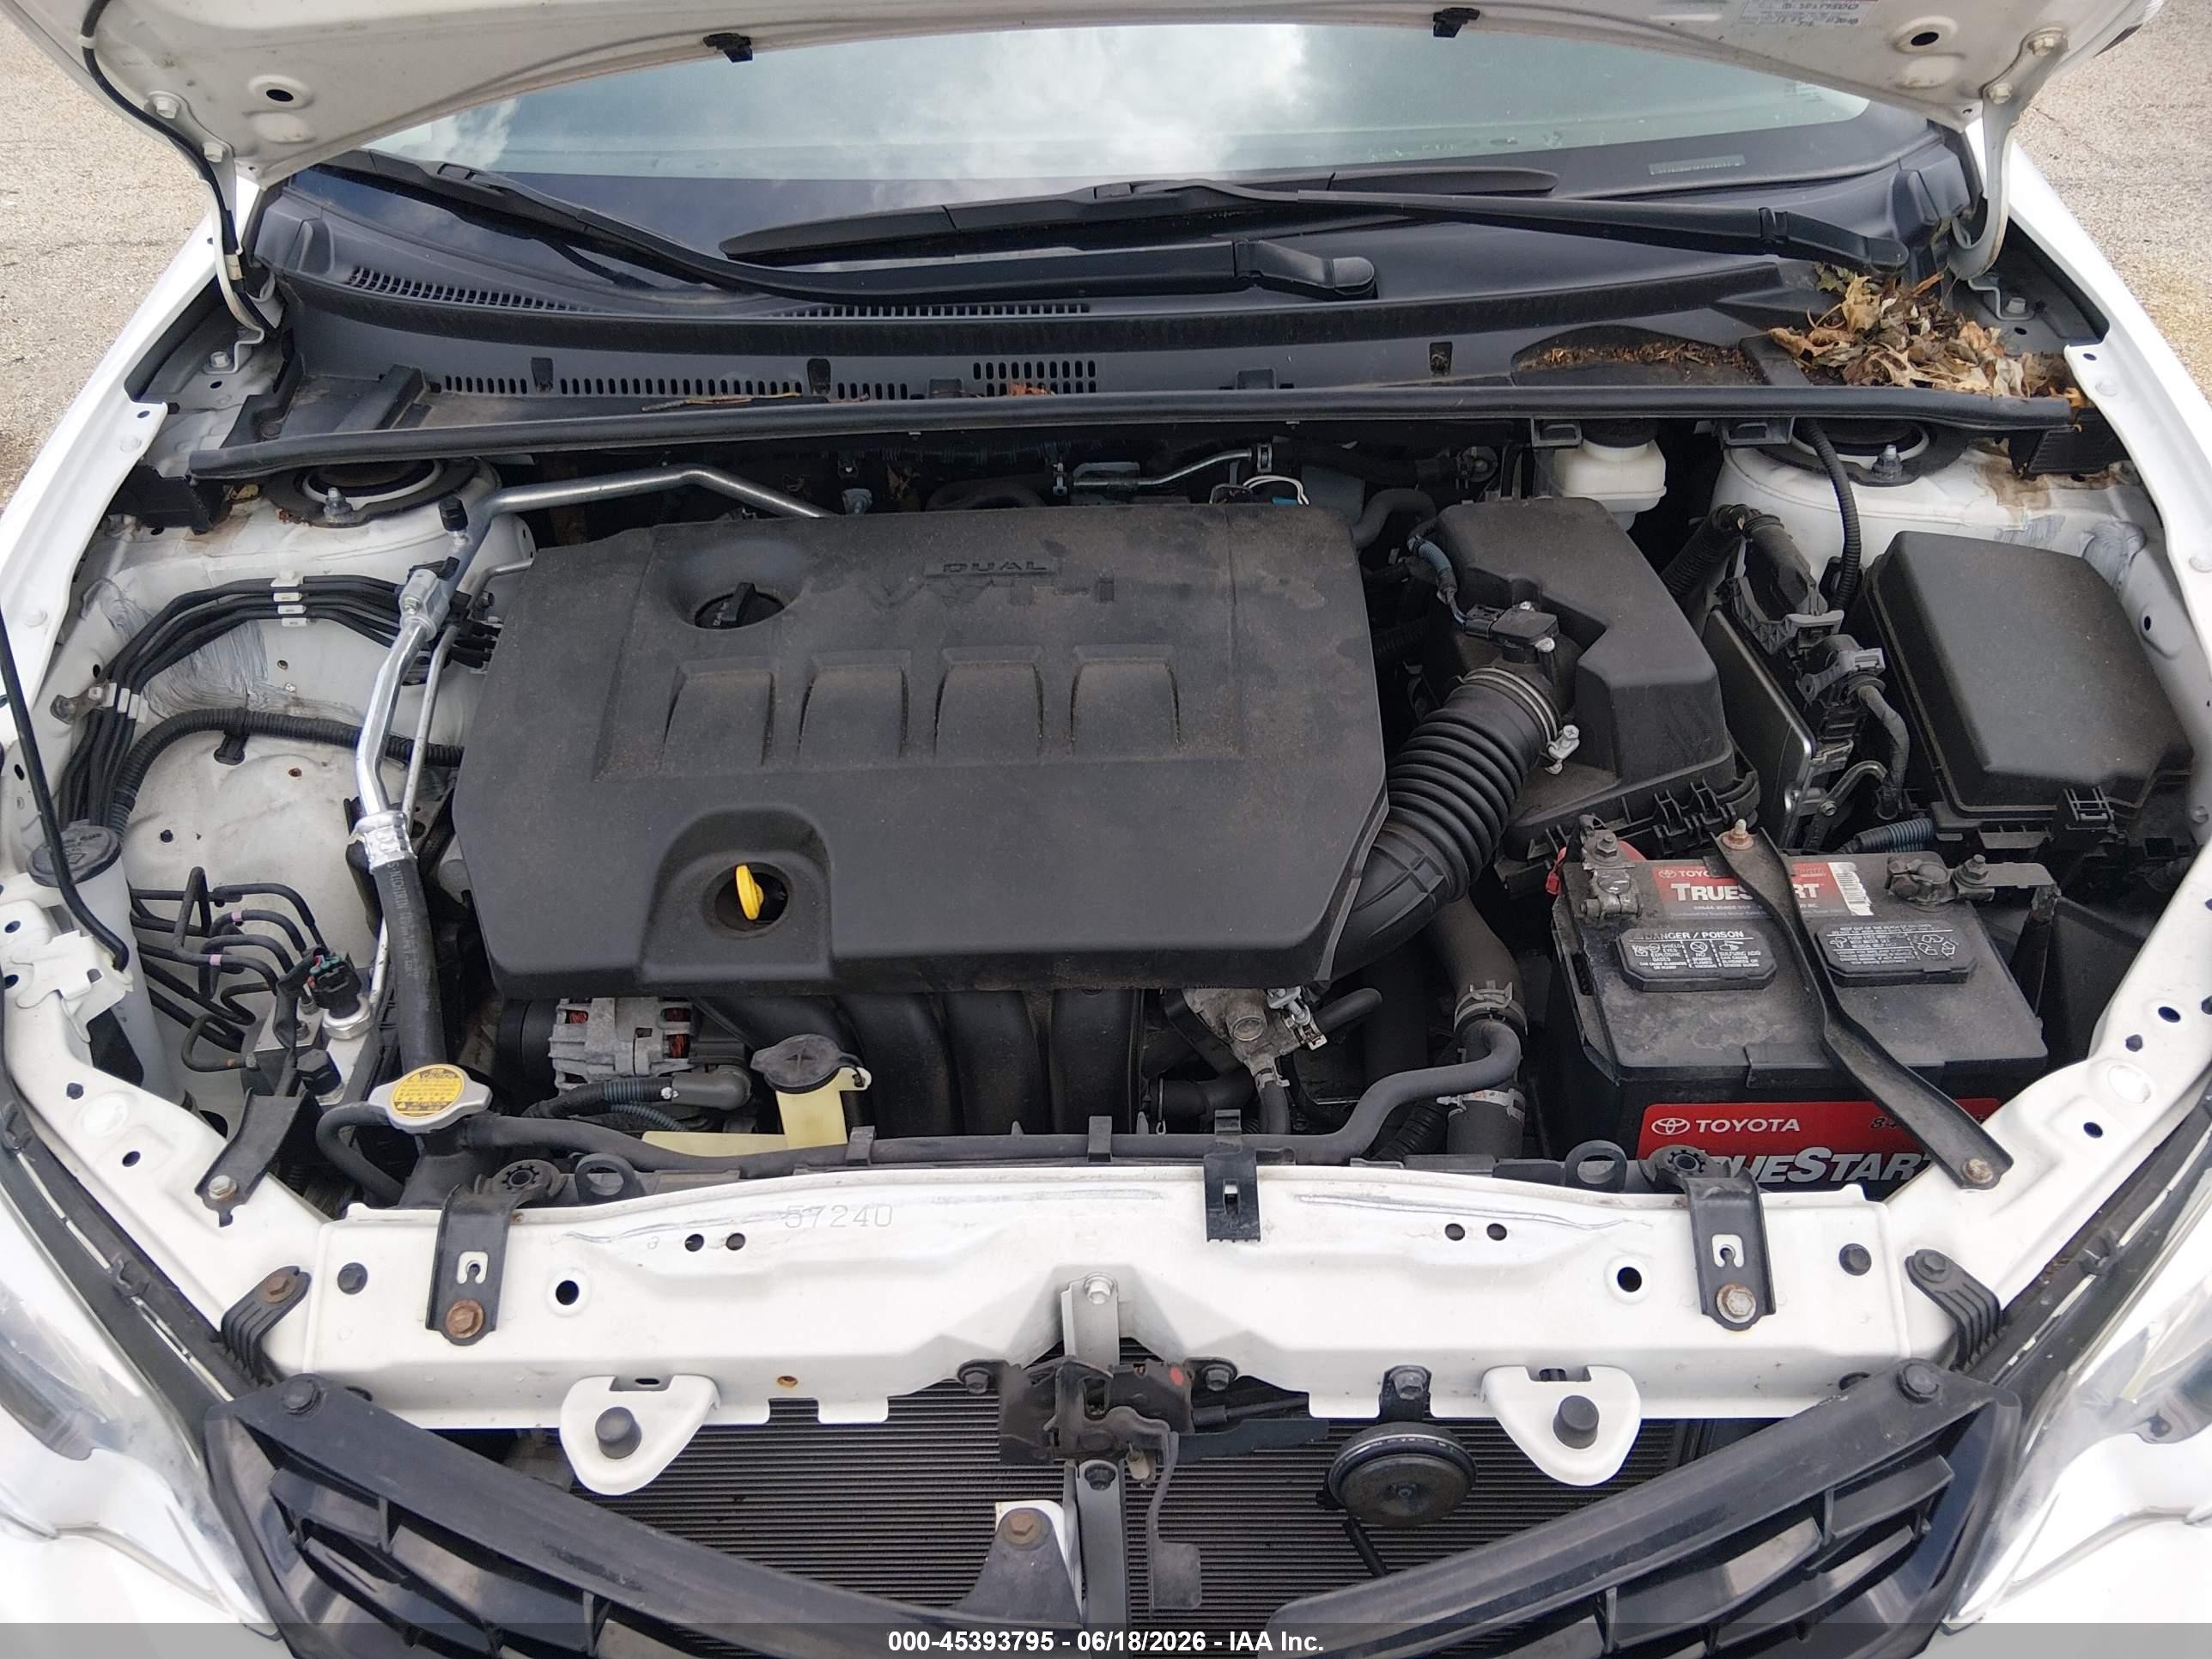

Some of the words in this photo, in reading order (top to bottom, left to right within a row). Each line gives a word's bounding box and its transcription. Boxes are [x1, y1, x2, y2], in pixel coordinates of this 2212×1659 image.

[943, 561, 1048, 574] DUAL
[1701, 930, 1745, 939] POISON
[1695, 1118, 1801, 1133] TOYOTA
[785, 1204, 894, 1229] 57240
